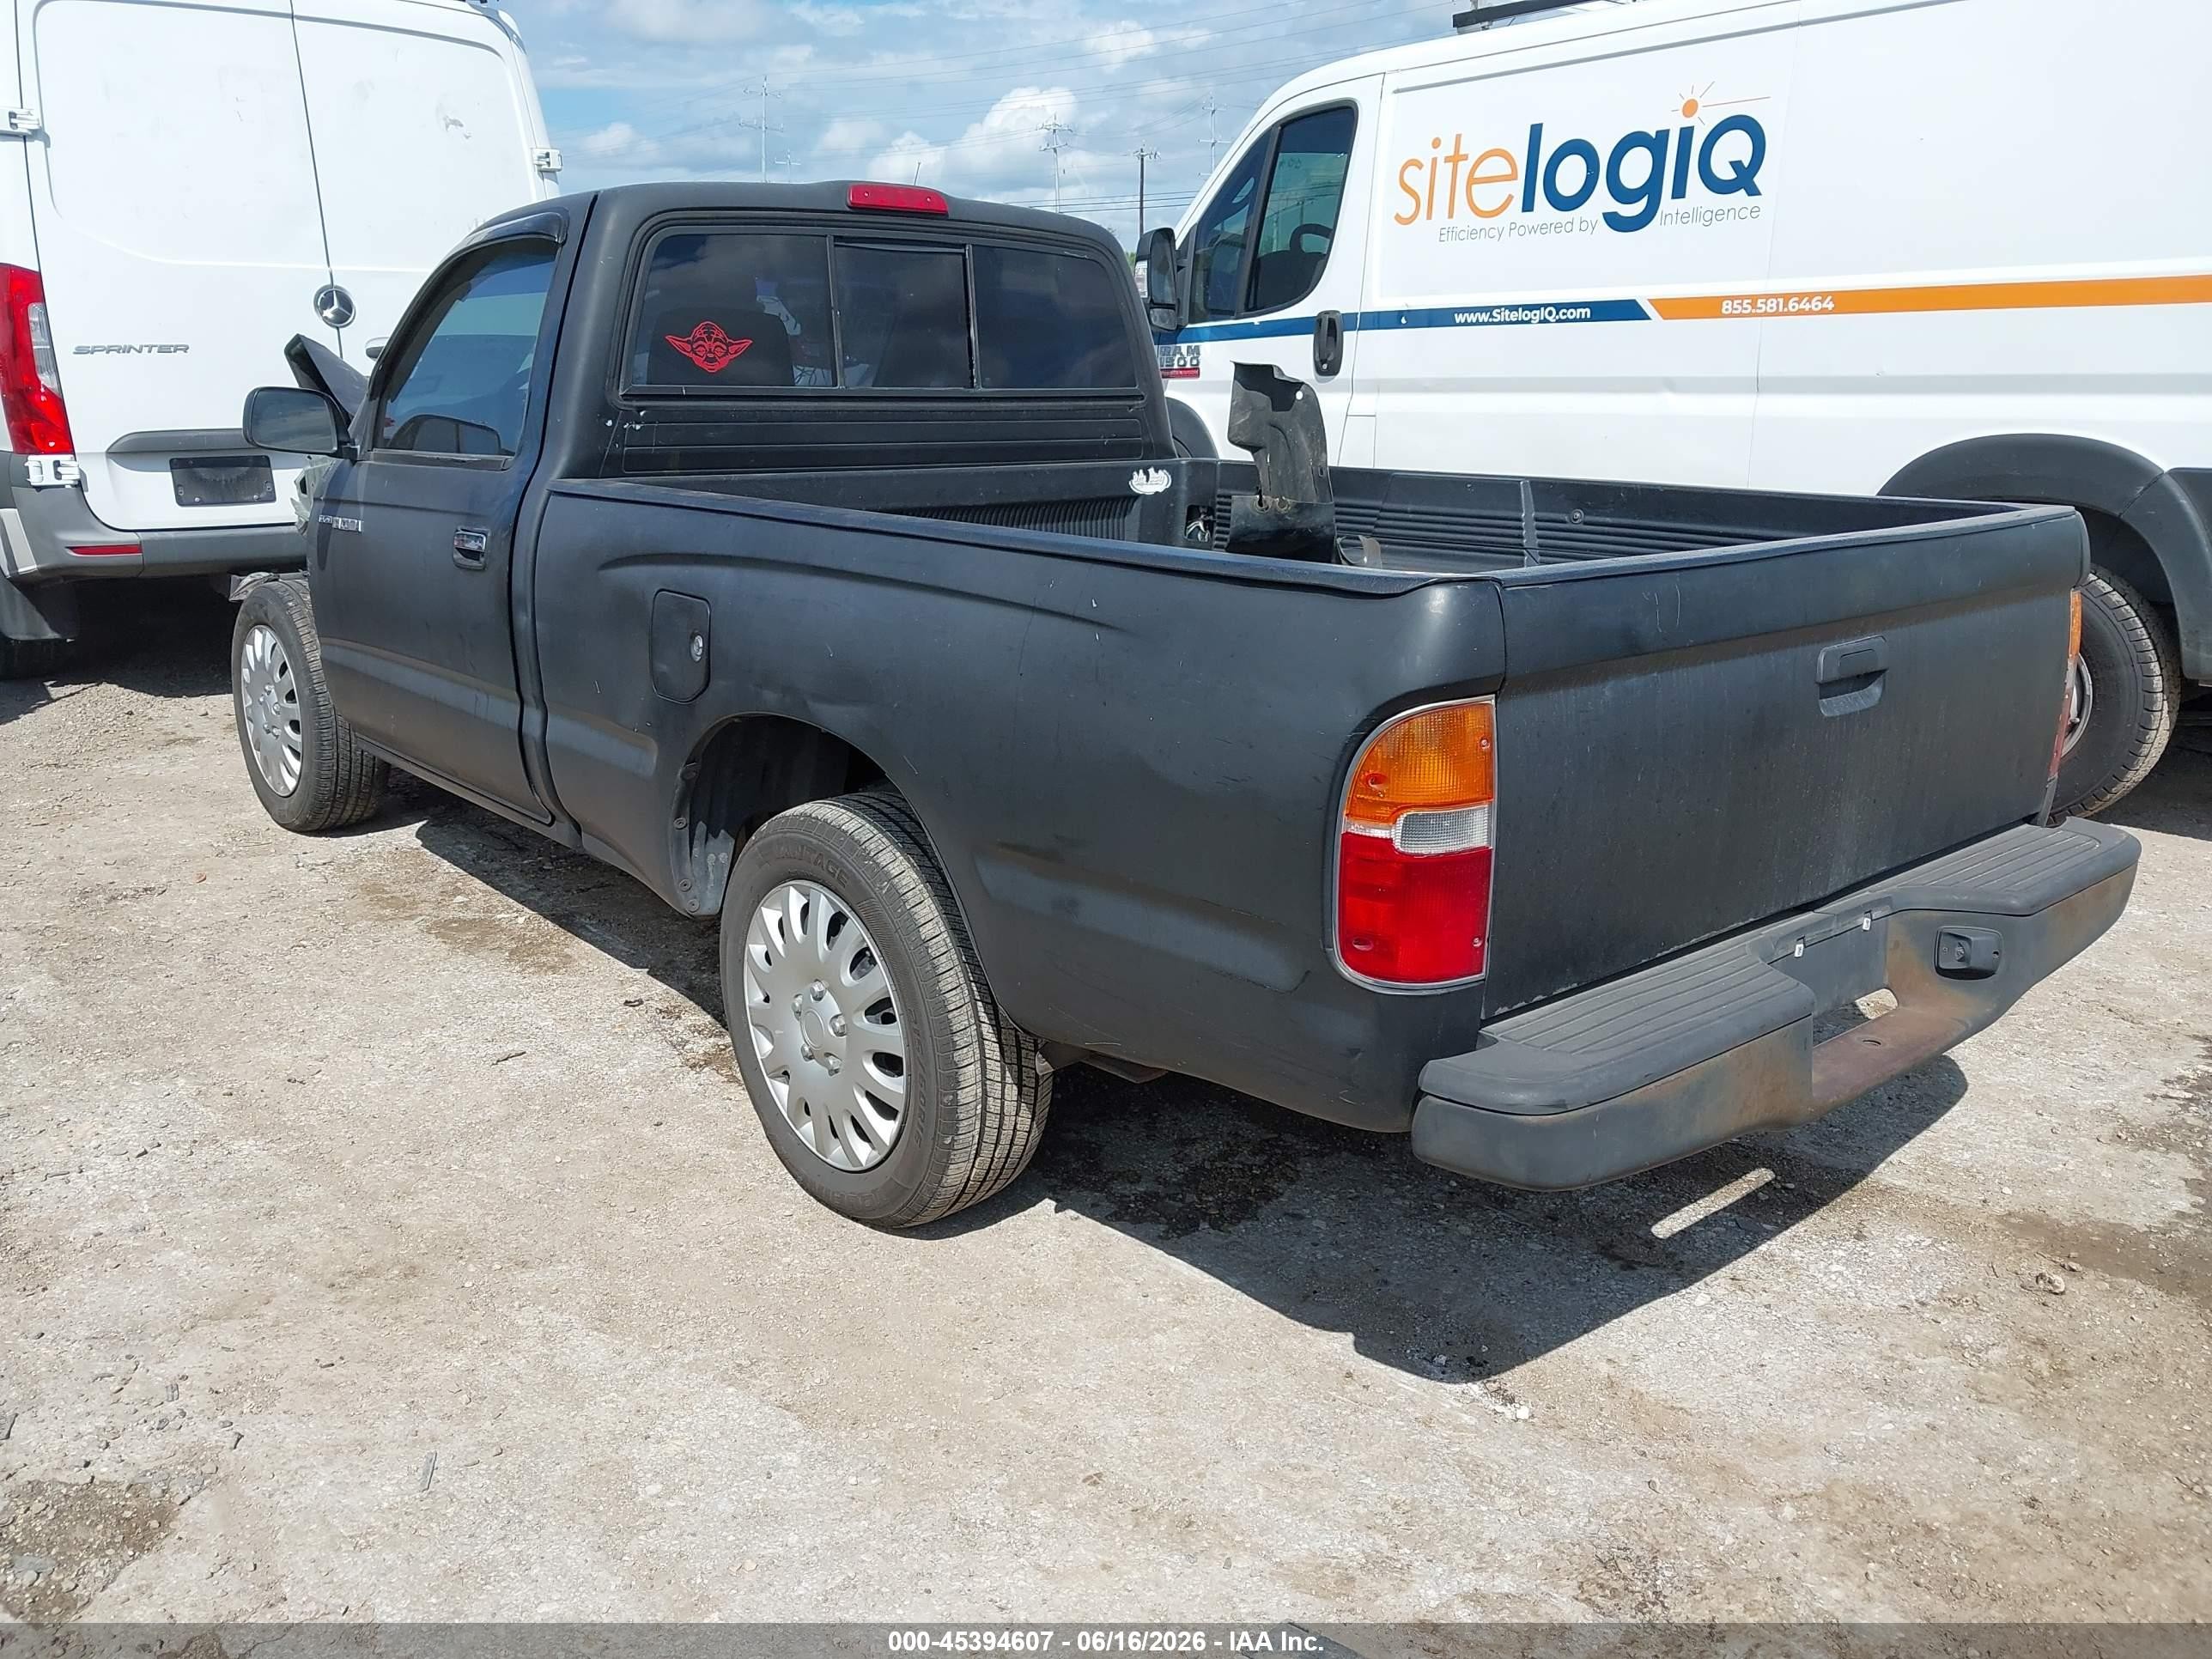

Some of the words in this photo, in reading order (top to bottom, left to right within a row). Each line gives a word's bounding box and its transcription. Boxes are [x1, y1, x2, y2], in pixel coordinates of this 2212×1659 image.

[1438, 226, 1504, 243] Efficiency
[1509, 217, 1575, 238] Powered
[1579, 216, 1599, 235] by
[1659, 205, 1761, 228] Intelligence
[1721, 295, 1835, 314] 855.581.6464
[1454, 305, 1591, 325] www.SitelogIQ.com
[72, 343, 190, 355] SPRINTER
[1160, 344, 1200, 357] RAM
